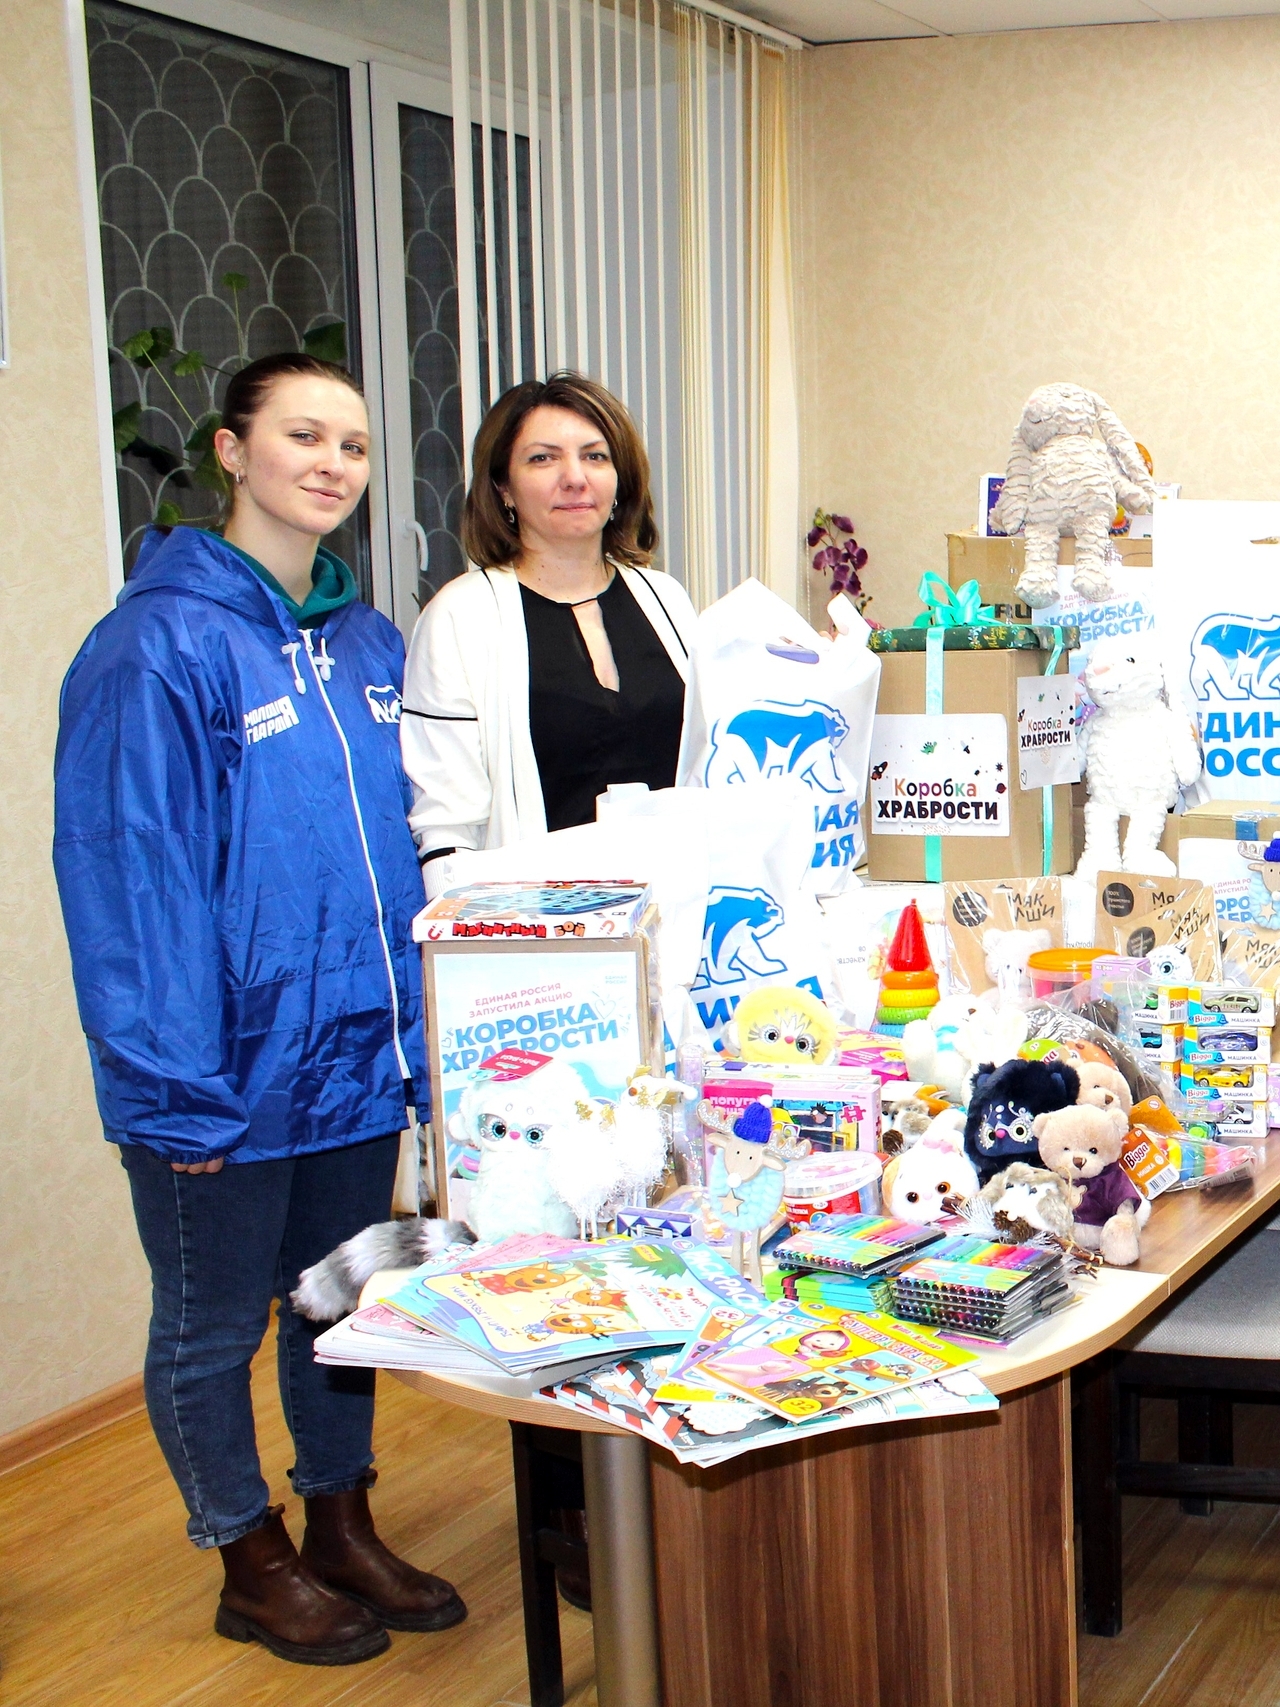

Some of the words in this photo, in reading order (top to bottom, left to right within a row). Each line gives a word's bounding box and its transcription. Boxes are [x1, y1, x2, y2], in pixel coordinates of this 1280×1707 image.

[1080, 614, 1156, 643] БРОСТИ
[1028, 717, 1062, 733] Коробка
[1021, 730, 1071, 748] ХРАБРОСТИ
[894, 777, 977, 800] Коробка
[877, 800, 998, 820] ХРАБРОСТИ
[1214, 886, 1249, 895] АПУСТИЛА
[469, 1001, 531, 1018] ЗАПУСТИЛА
[534, 991, 573, 1006] АКЦИЮ
[475, 991, 517, 1007] ЕДИНАЯ
[520, 982, 562, 997] РОССИЯ
[455, 1002, 599, 1048] КОРОБКА
[1194, 1014, 1216, 1024] Bigga
[1190, 1053, 1212, 1062] Bigga
[1187, 1089, 1209, 1098] Bigga
[1125, 1142, 1150, 1168] Bigga
[682, 1250, 764, 1311] РАСКРАС
